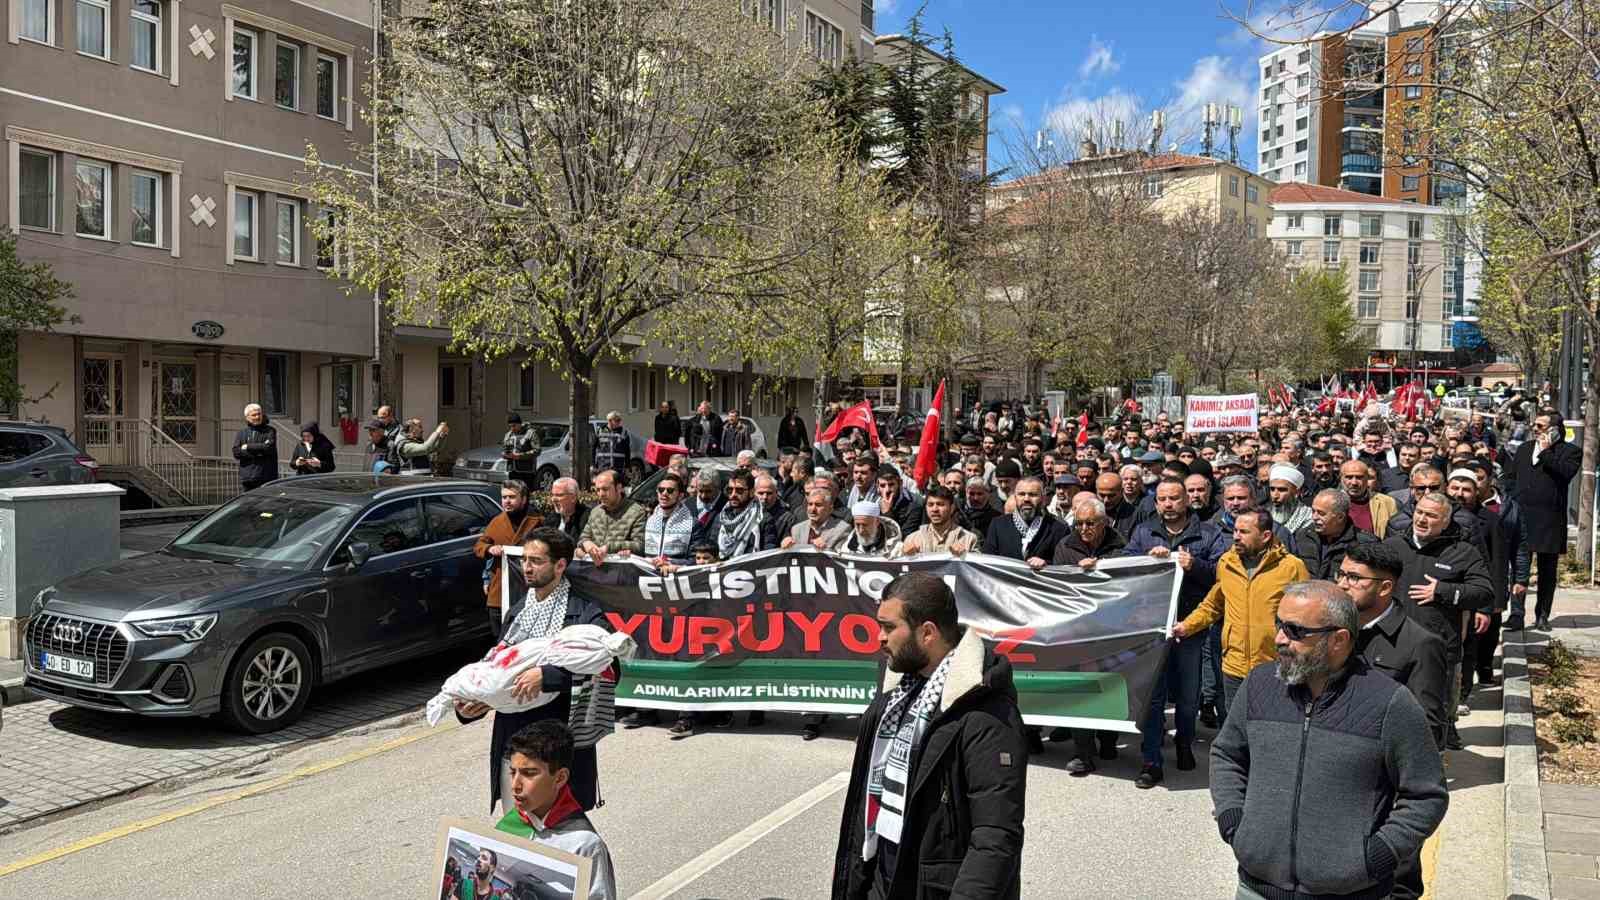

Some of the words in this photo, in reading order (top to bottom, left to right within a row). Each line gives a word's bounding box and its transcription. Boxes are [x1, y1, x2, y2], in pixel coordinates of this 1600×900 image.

[1190, 400, 1222, 412] KANIMIZ
[1225, 398, 1255, 410] AKSADA
[638, 558, 838, 601] FİLİSTİN
[605, 602, 1036, 662] YÜRÜYOZ
[77, 661, 91, 676] 120
[633, 683, 752, 698] ADIMLARIMIZ
[756, 683, 865, 700] FİLİSTİN'NİN
